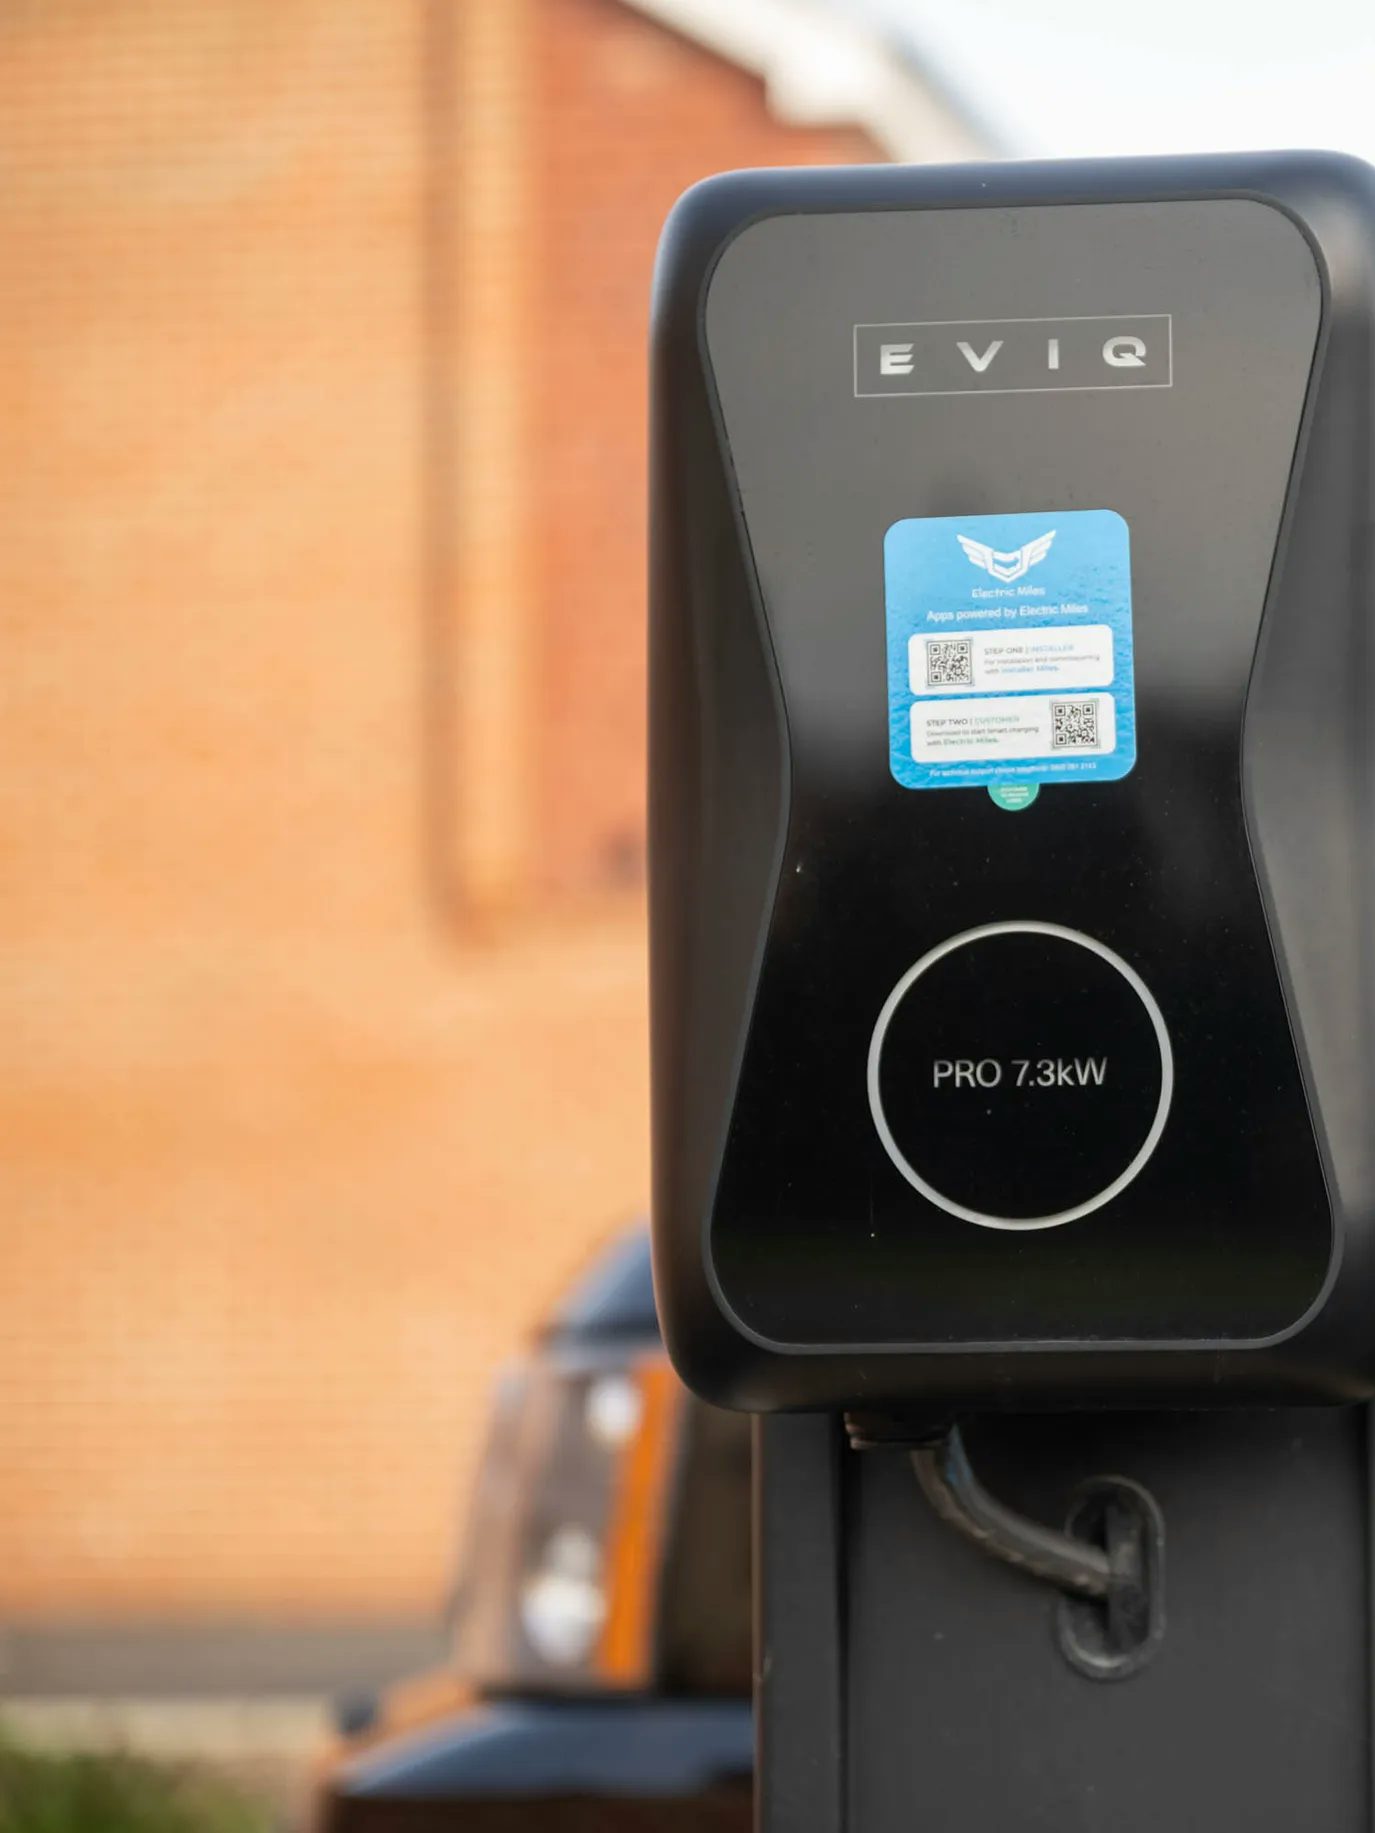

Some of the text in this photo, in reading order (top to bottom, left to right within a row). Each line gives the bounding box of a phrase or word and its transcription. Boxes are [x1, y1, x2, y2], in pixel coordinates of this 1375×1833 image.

[879, 336, 1147, 375] EVIQ
[971, 585, 1046, 599] Electric Miles
[926, 603, 1088, 623] Apps powered by Electric Miles
[984, 644, 1075, 656] STEP ONE INSTALLER
[926, 715, 1020, 727] STEP TWO CUSTOMER
[1008, 726, 1039, 735] charging
[933, 1056, 1108, 1088] PRO 7.3kW
